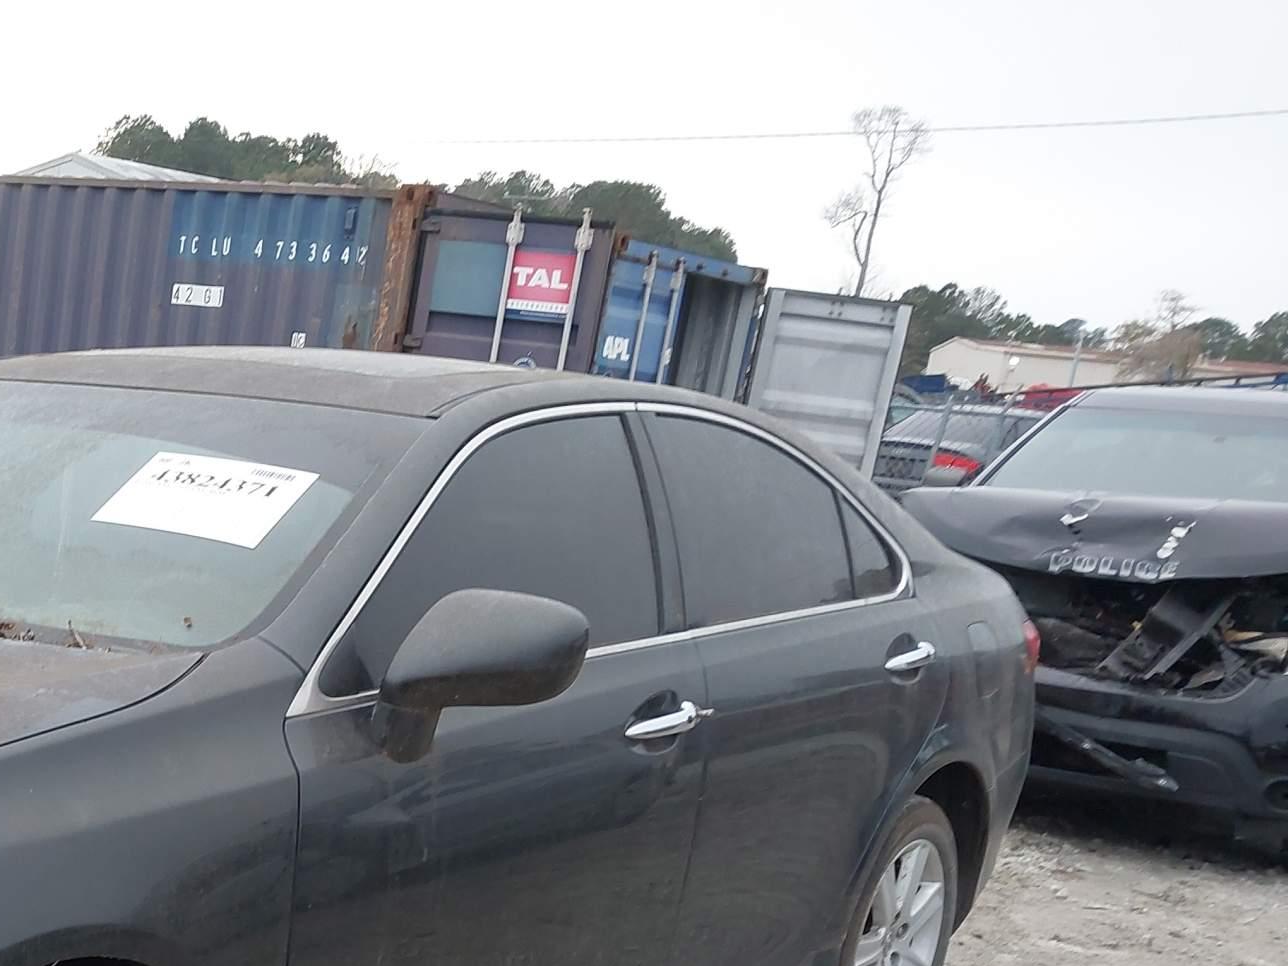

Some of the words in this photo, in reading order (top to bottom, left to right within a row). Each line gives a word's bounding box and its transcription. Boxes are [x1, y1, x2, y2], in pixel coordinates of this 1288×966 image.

[513, 265, 569, 290] TAL
[602, 335, 631, 362] APL
[1047, 553, 1180, 580] POLICE
